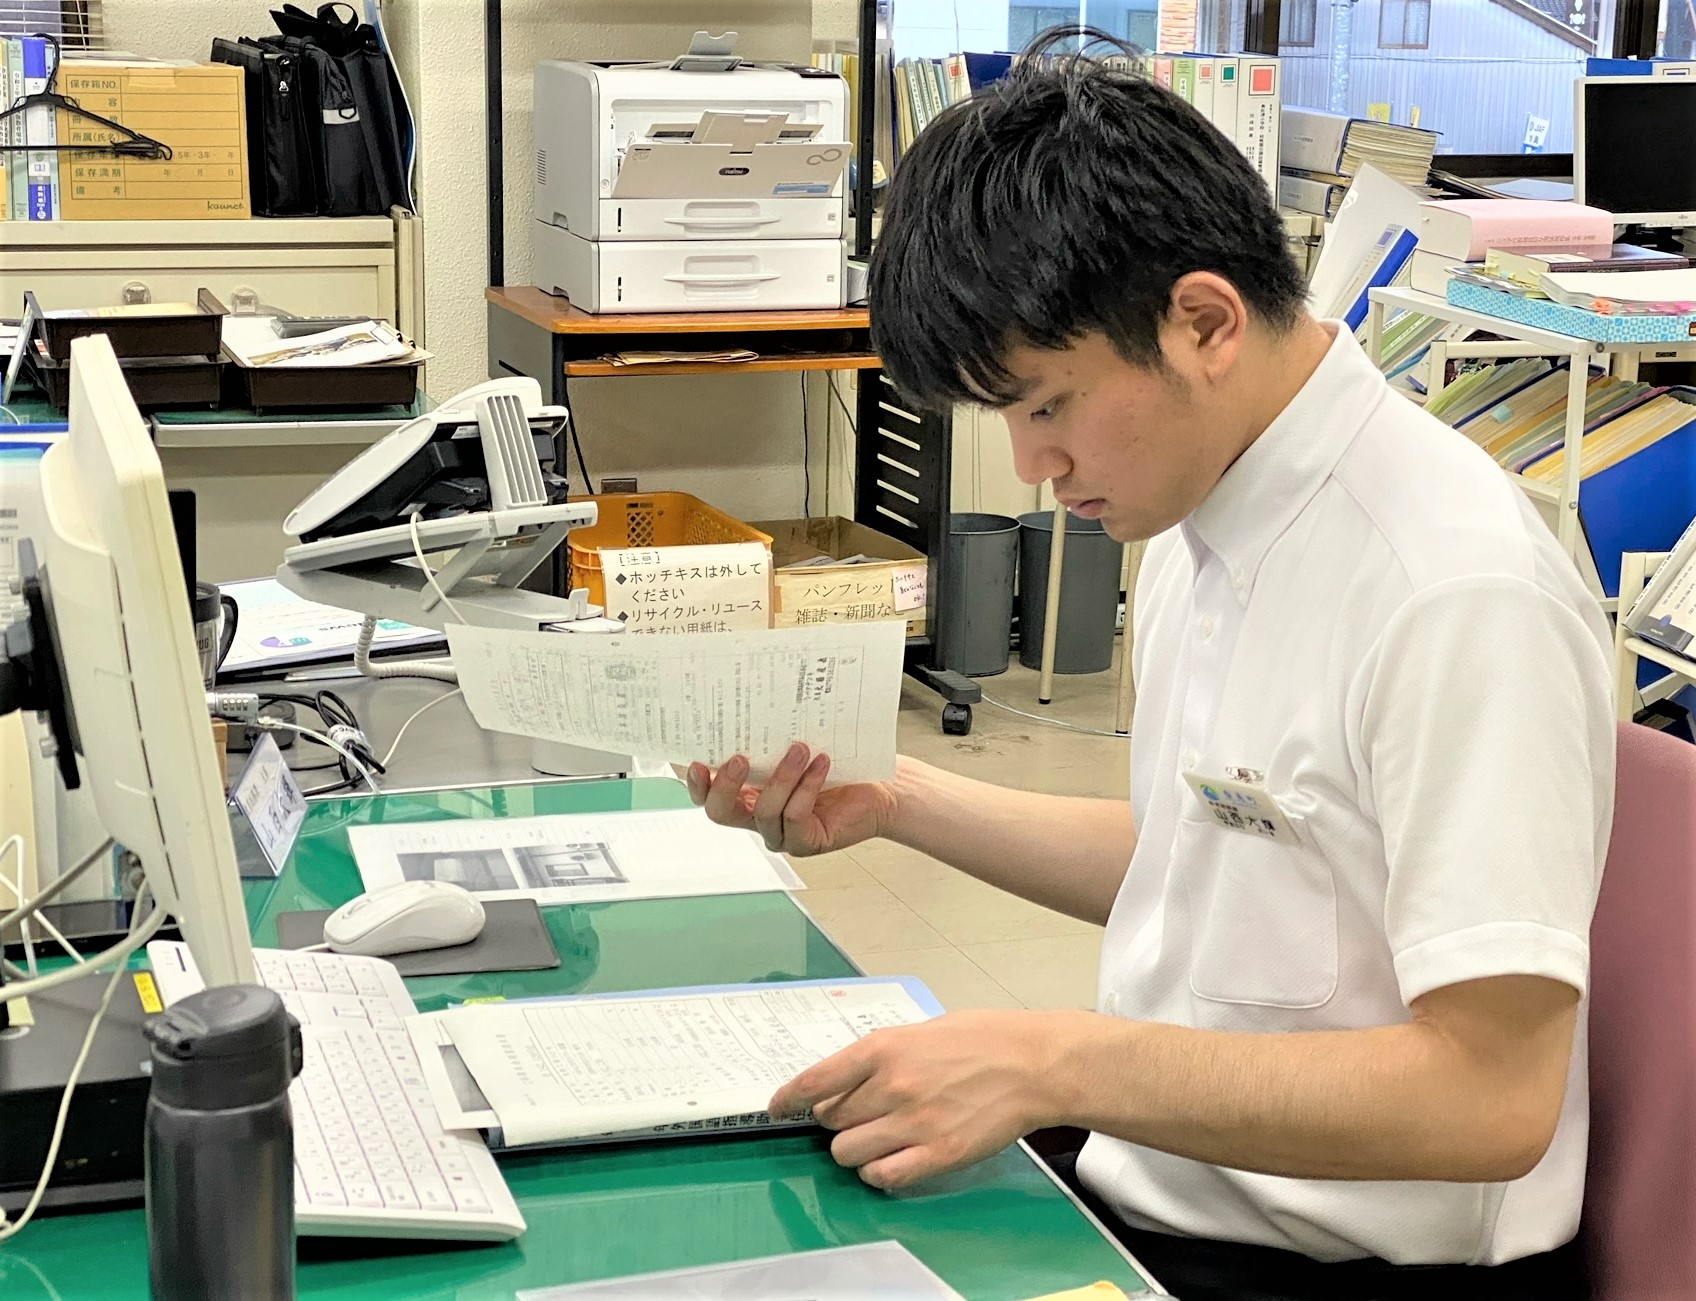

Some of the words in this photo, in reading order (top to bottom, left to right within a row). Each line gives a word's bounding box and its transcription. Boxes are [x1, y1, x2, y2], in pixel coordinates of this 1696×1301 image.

[71, 80, 118, 88] 保存箱NO.
[207, 201, 244, 210] kaunet
[630, 562, 762, 584] ホッチキスは外して
[632, 588, 685, 603] ください
[632, 600, 763, 622] リサイクル・リユース
